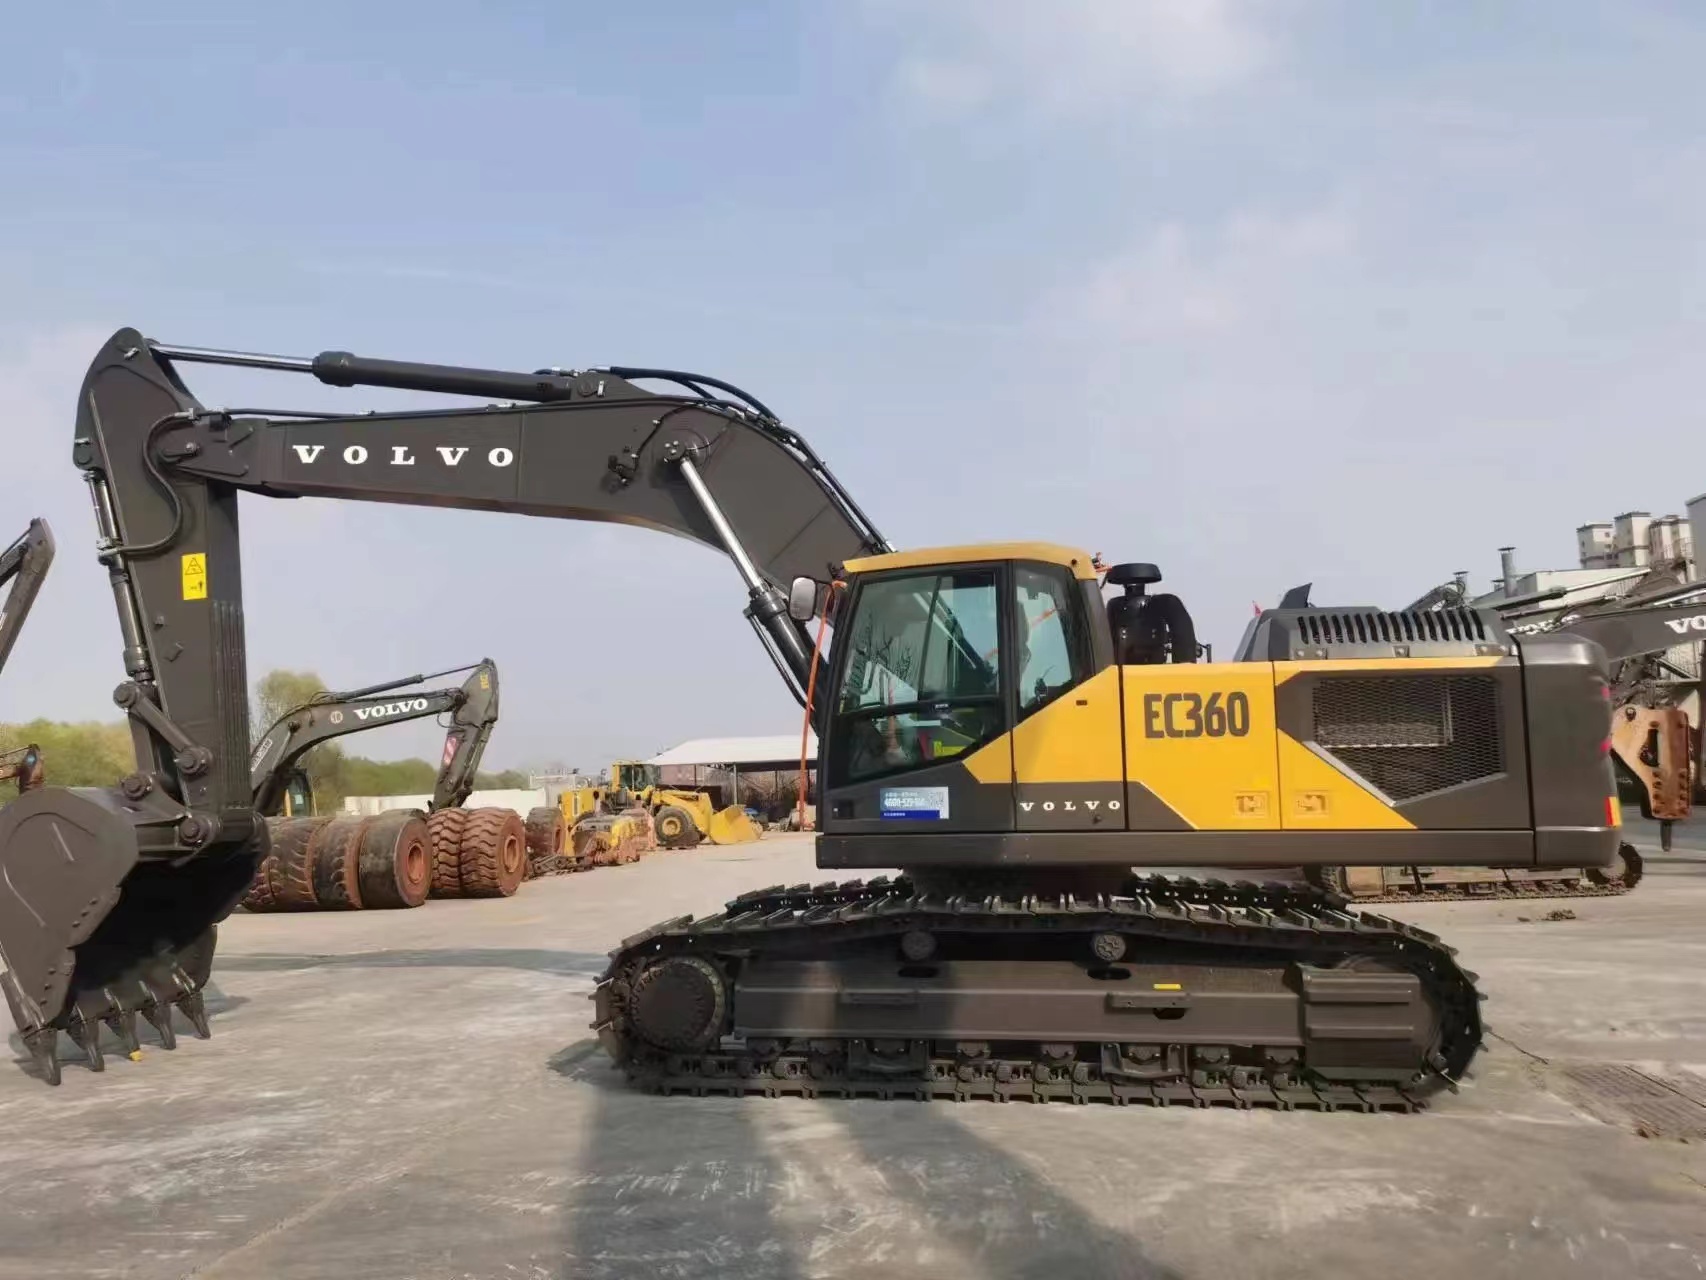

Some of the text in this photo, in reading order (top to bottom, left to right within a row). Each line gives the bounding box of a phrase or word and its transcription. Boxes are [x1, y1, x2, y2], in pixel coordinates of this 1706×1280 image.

[292, 445, 514, 467] VOLVO
[354, 698, 428, 720] VOLVO
[1143, 691, 1250, 739] EC360
[1019, 800, 1121, 811] VOLVO
